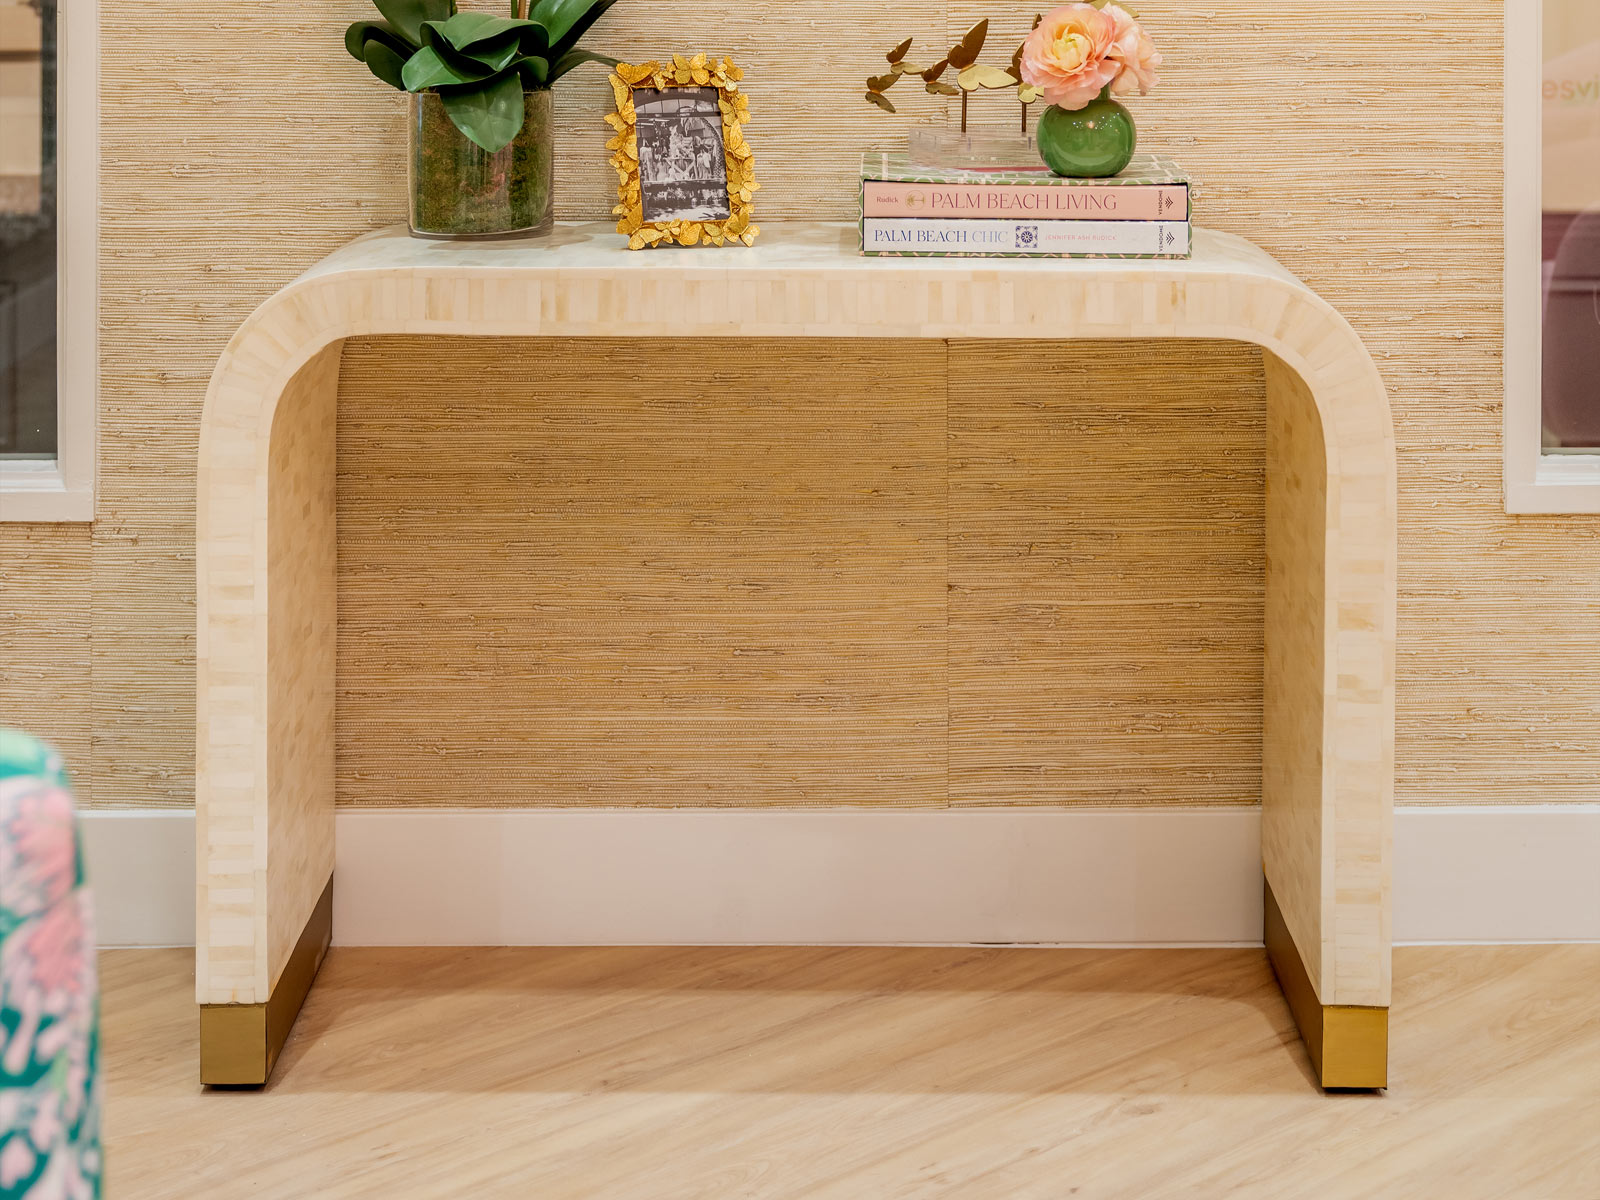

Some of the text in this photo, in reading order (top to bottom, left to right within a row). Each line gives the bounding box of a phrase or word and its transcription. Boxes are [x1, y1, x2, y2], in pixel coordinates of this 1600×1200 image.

[876, 196, 899, 204] Rudick
[931, 192, 1117, 210] PALM BEACH LIVING
[874, 229, 1008, 243] PALM BEACH CHIC
